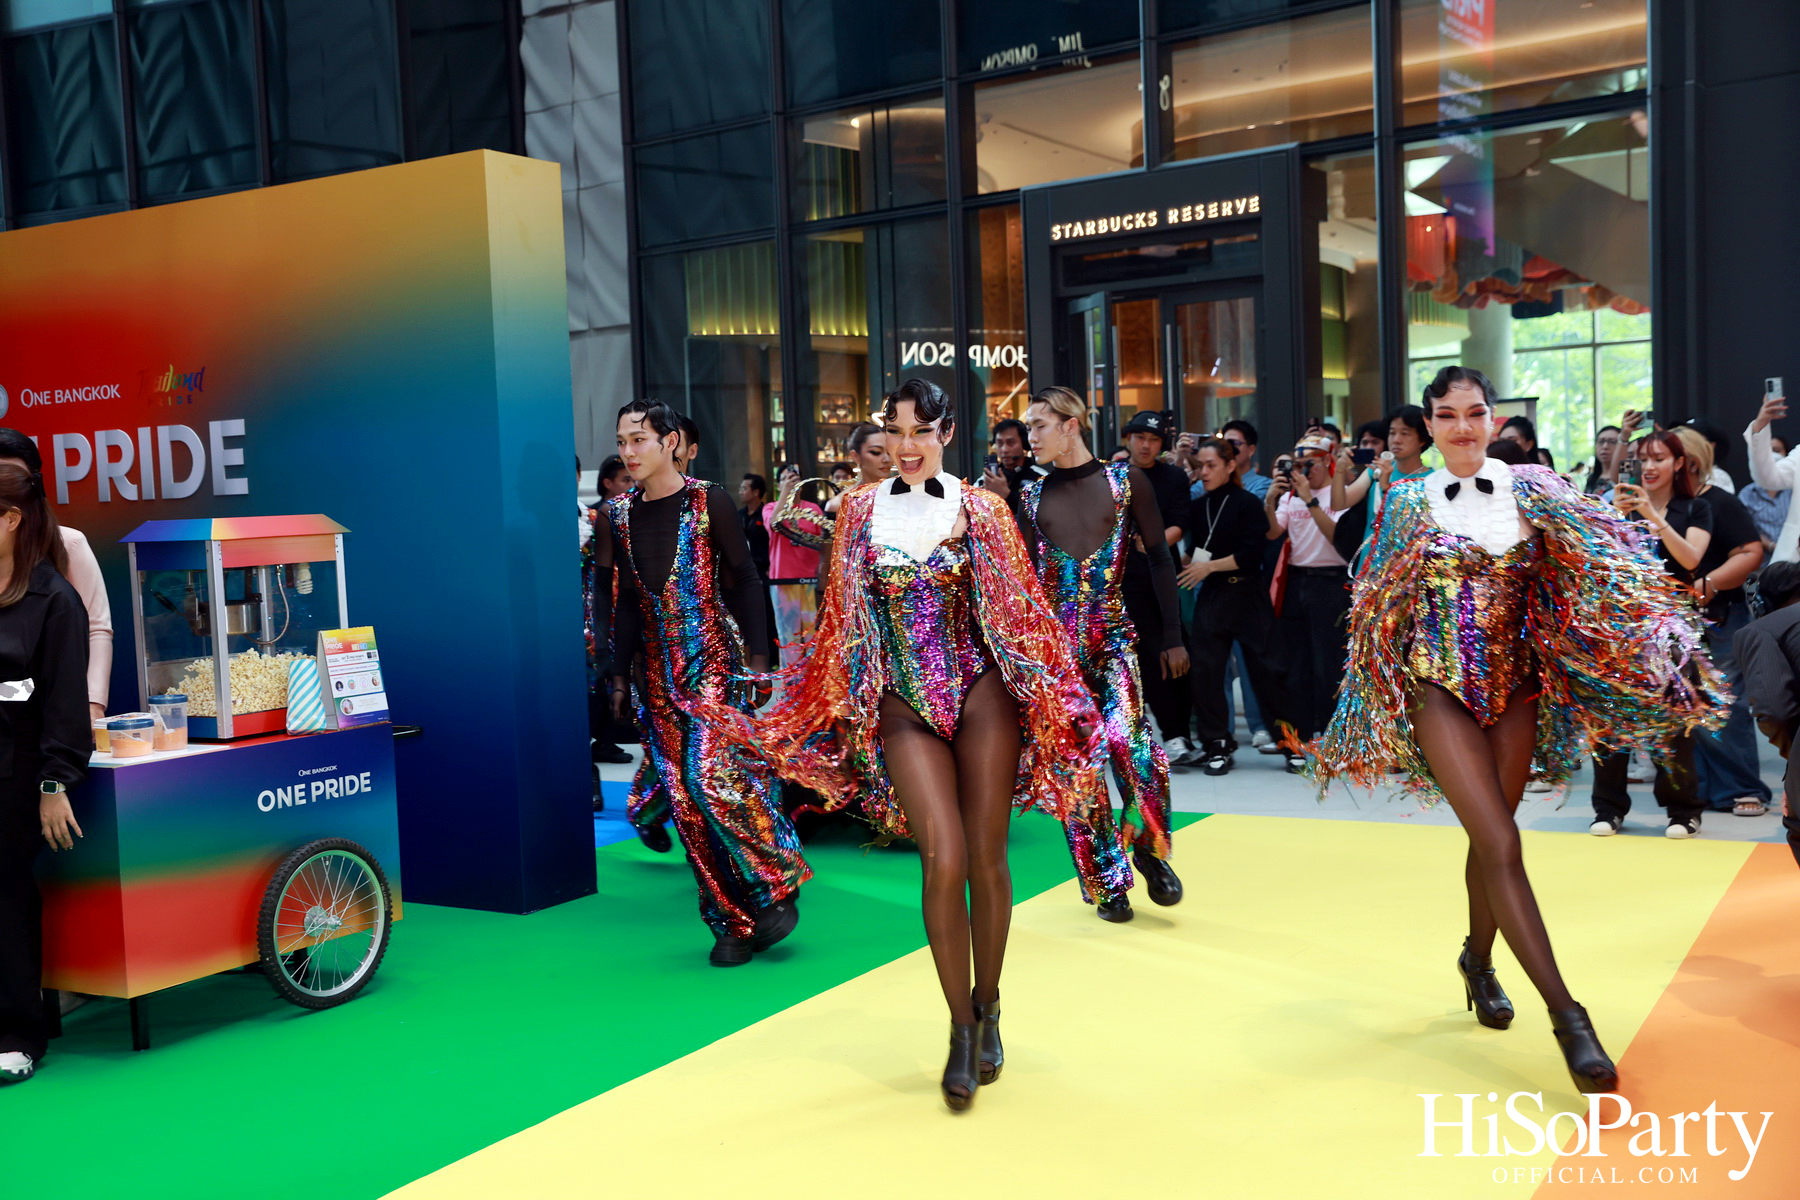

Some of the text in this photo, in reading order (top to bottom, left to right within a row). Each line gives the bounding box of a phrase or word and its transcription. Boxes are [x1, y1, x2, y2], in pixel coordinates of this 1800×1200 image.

[1051, 196, 1260, 241] STARBUCKS RESERVE
[20, 384, 121, 408] ONE BANGKOK
[52, 418, 249, 505] PRIDE
[312, 765, 338, 775] BANGKOK
[257, 771, 372, 812] ONE PRIDE
